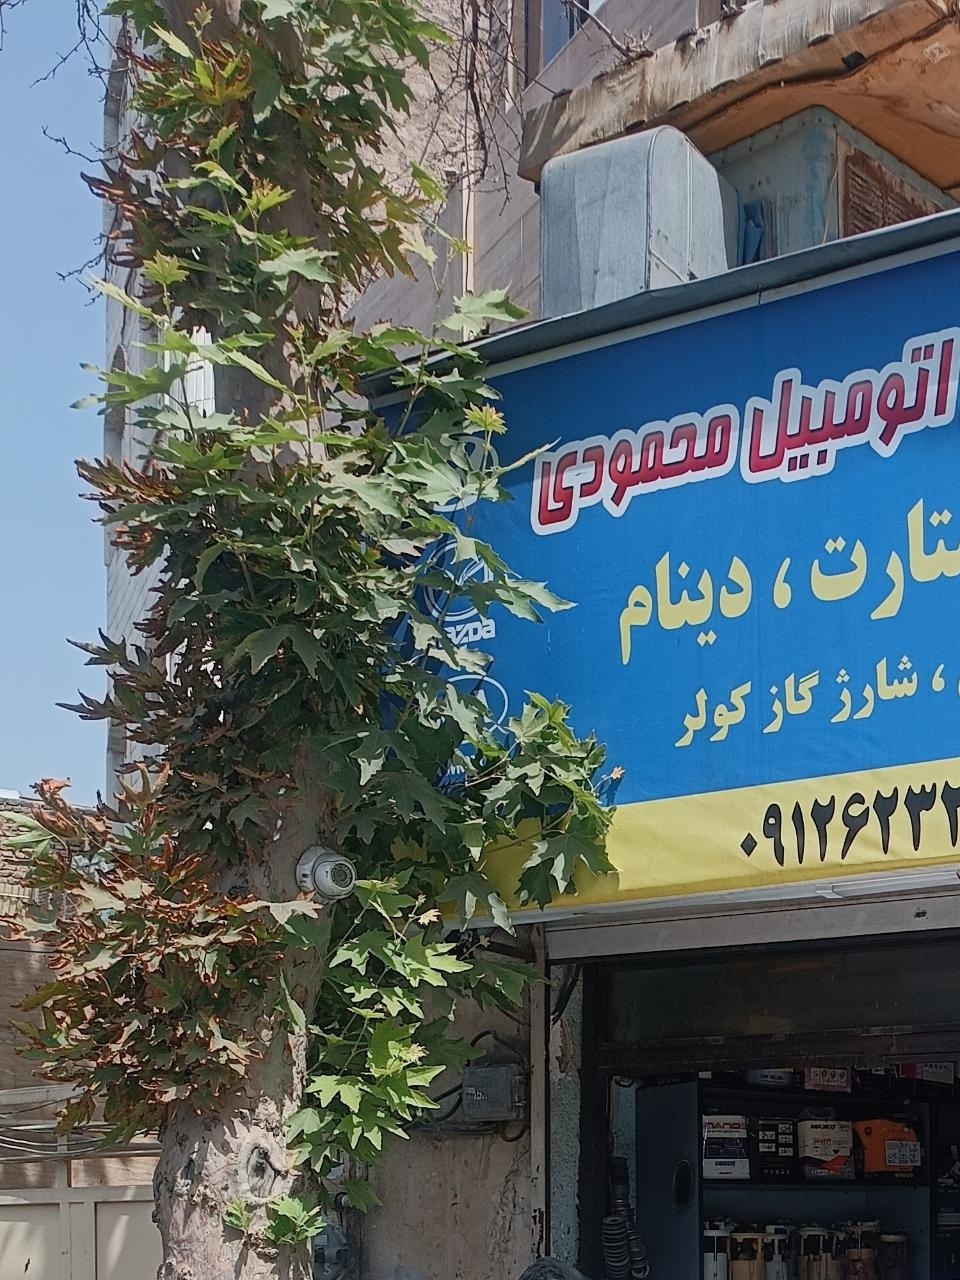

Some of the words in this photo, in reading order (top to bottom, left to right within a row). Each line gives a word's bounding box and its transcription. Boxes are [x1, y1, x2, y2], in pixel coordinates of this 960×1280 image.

[744, 334, 957, 479] اتومبیل
[534, 406, 737, 531] محمودی
[618, 551, 754, 666] دینام
[674, 680, 752, 748] کولر
[762, 669, 820, 733] گاز
[830, 653, 919, 723] شارژ
